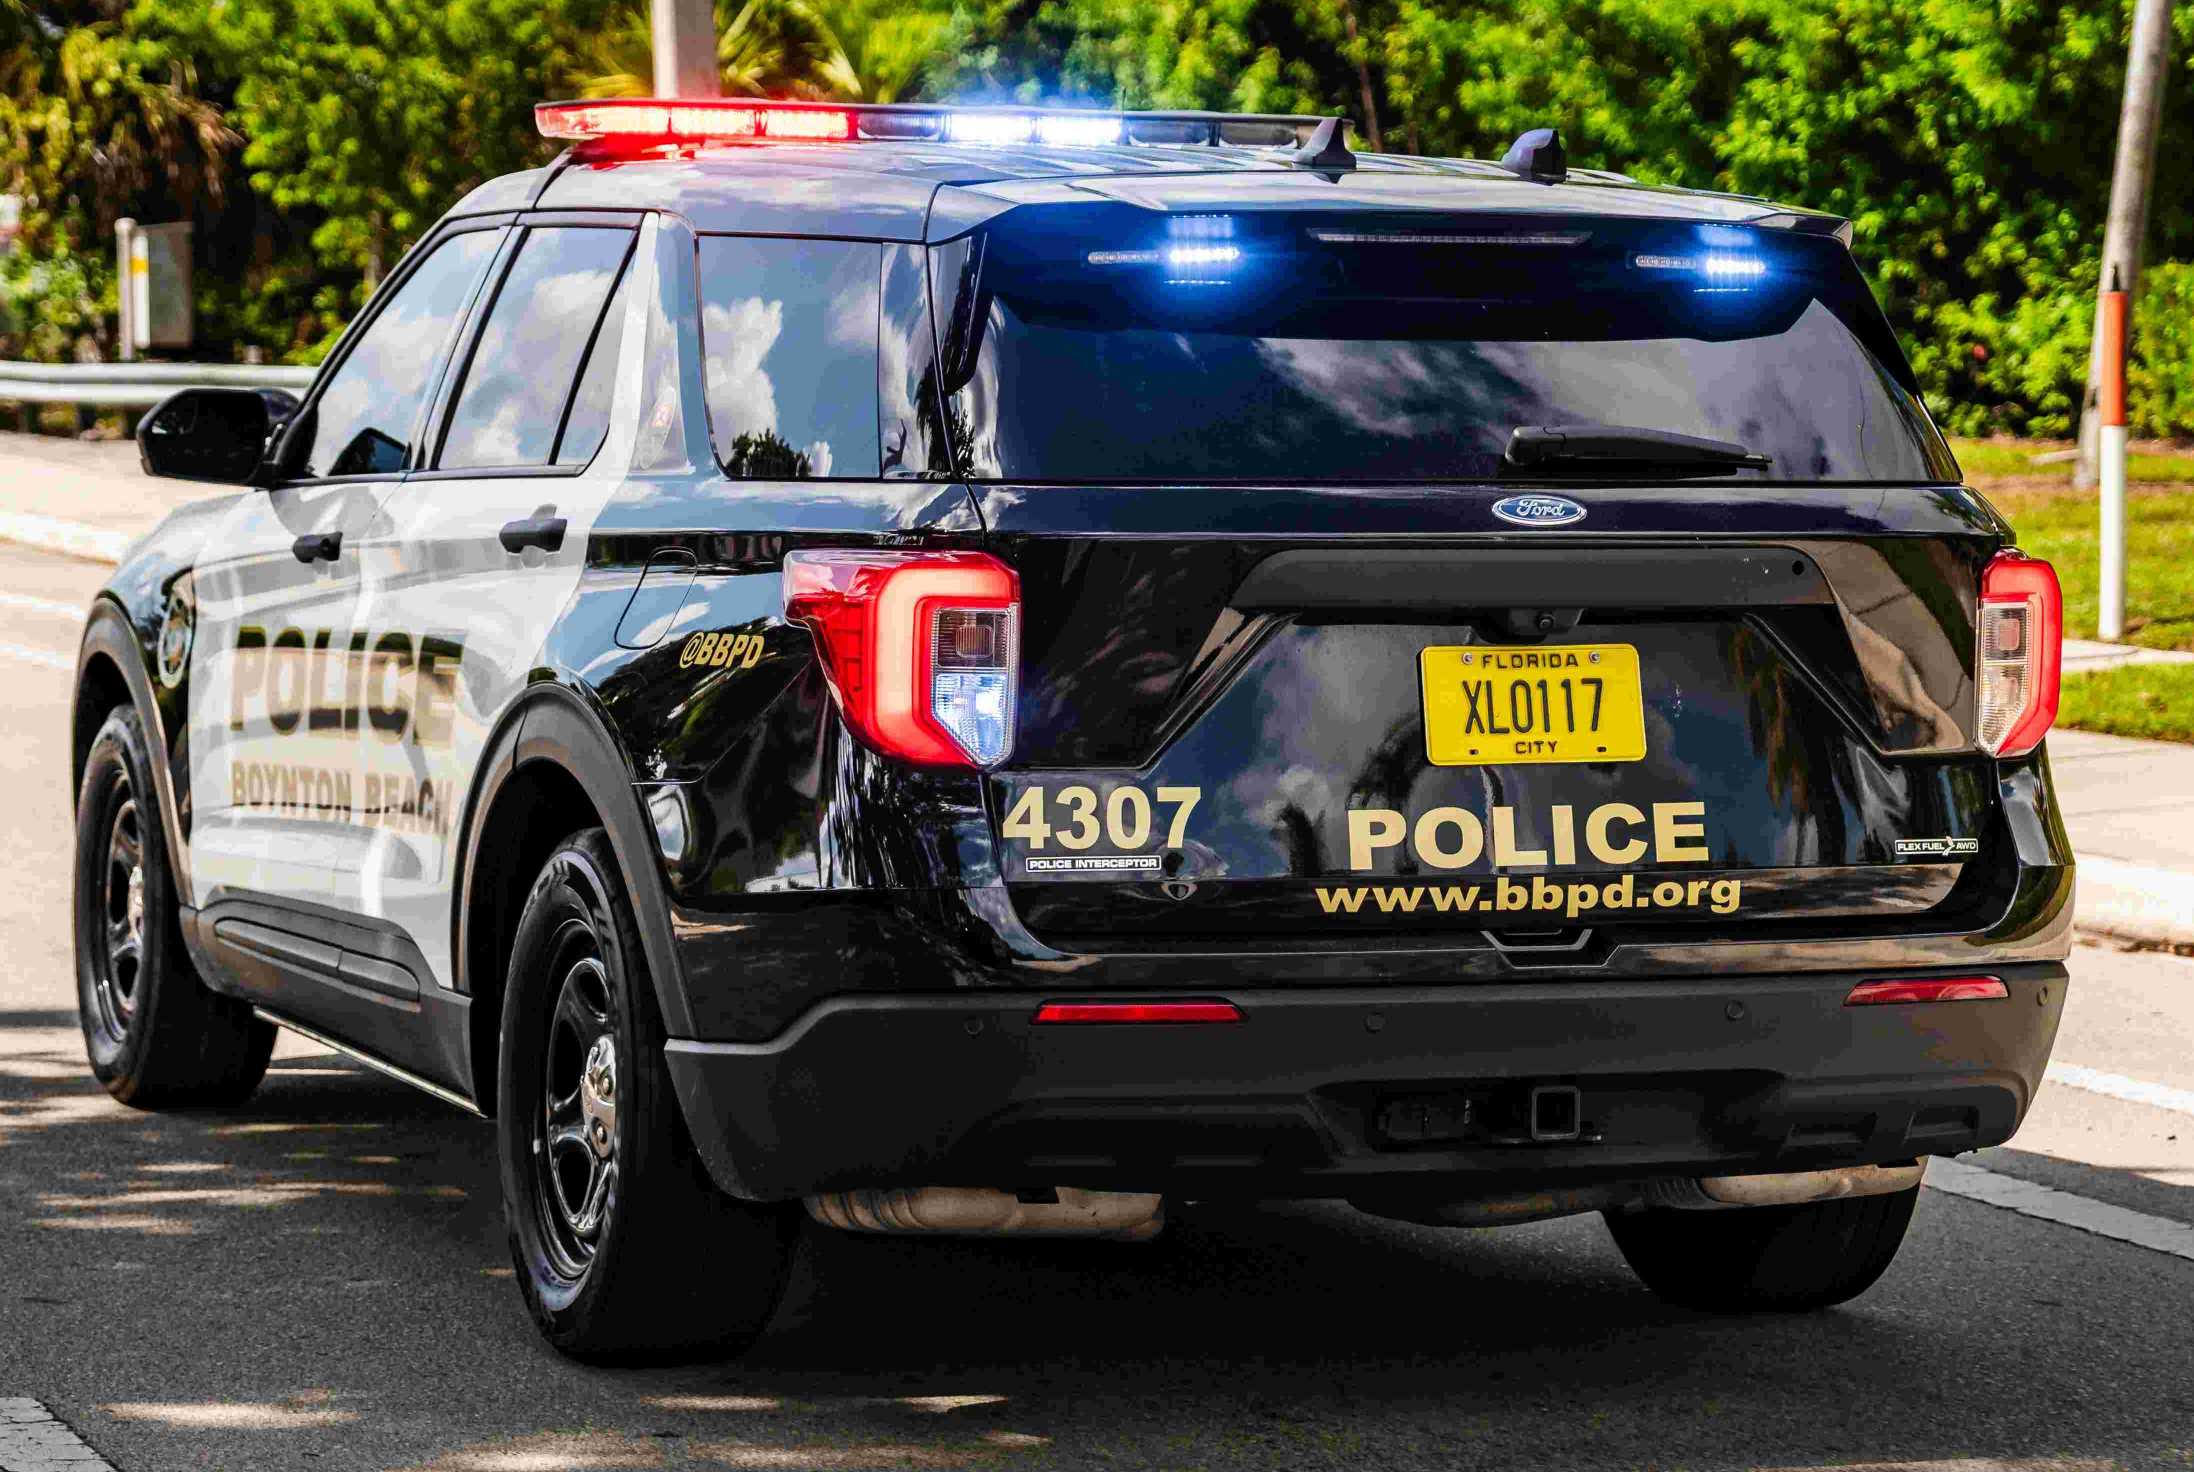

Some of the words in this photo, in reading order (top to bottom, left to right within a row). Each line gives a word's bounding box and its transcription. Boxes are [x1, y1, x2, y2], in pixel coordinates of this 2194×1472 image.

[1516, 499, 1566, 516] Ford
[680, 631, 765, 669] @BBPD
[1481, 653, 1579, 669] FLORIDA
[230, 626, 466, 747] POLICE
[1461, 678, 1603, 734] XL0117
[1515, 741, 1558, 754] CITY
[231, 759, 352, 823] BOYNTON
[363, 772, 454, 837] BEACH
[1002, 786, 1202, 849] 4307
[1347, 801, 1710, 870] POLICE
[1897, 843, 1921, 851] FLEX
[1922, 842, 1945, 850] FUEL
[1955, 842, 1976, 850] AWD
[1029, 860, 1072, 869] POLICE
[1075, 859, 1157, 869] INTERCEPTOR
[1315, 874, 1742, 918] www.bbpd.org
